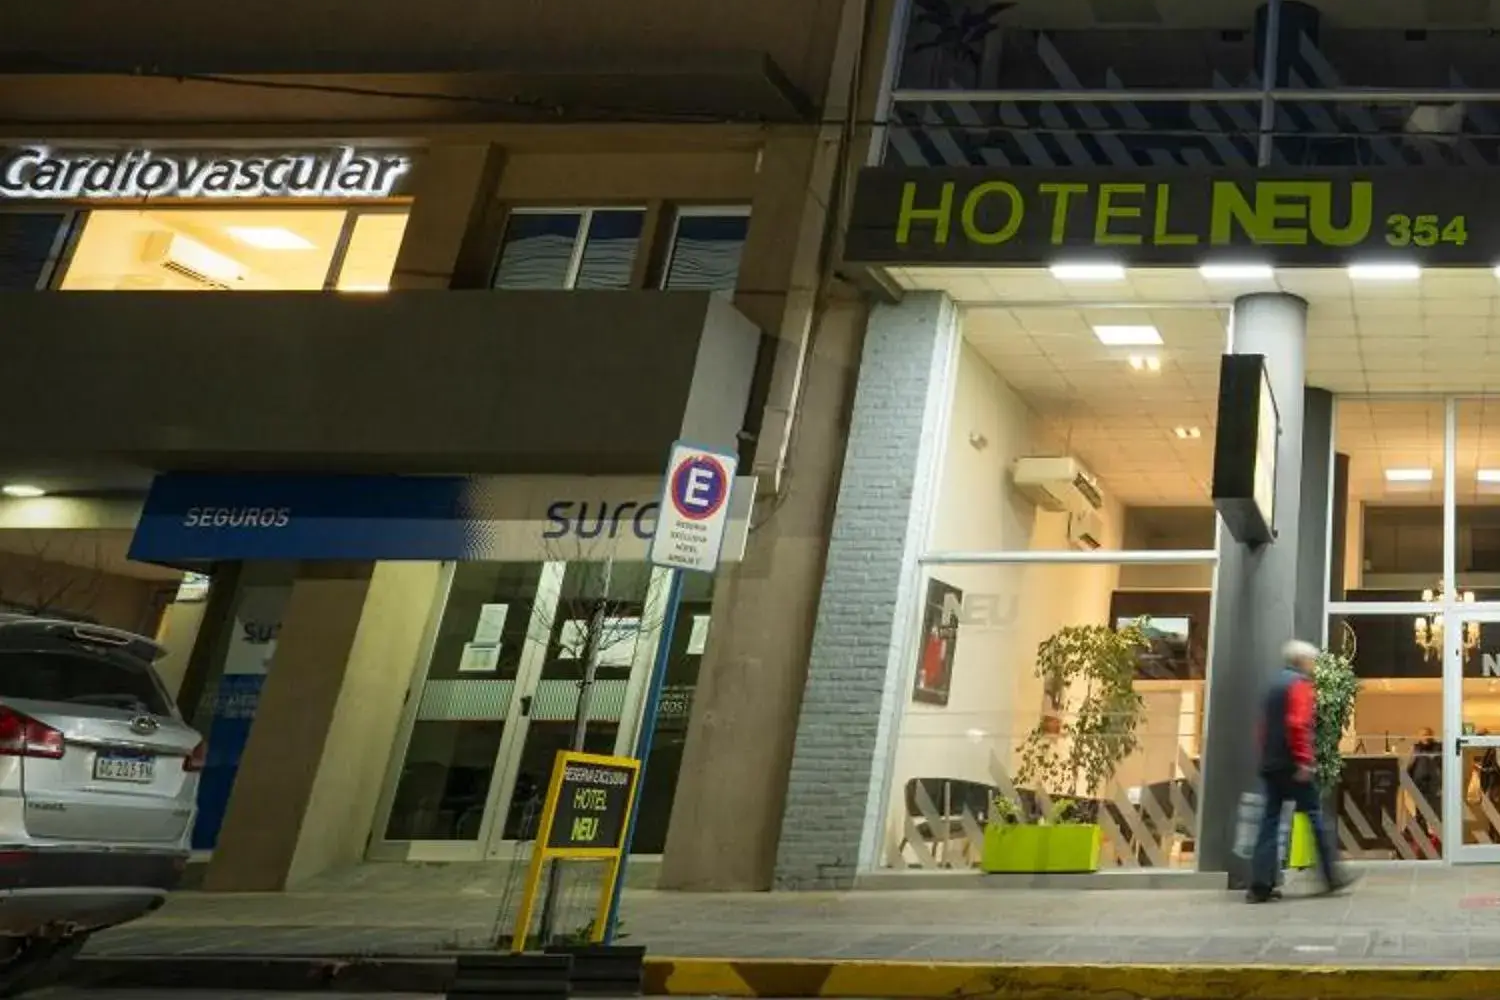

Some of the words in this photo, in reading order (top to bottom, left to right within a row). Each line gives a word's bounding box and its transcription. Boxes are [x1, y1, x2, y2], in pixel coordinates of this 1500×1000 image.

[1, 148, 404, 195] Cardiovascular
[895, 181, 1198, 245] HOTEL
[1210, 181, 1373, 246] NEU
[1385, 214, 1468, 247] 354
[684, 467, 715, 507] E
[184, 507, 290, 527] SEGUROS
[941, 593, 1020, 626] NEU
[573, 787, 607, 811] HOTEL
[571, 817, 599, 841] NEU
